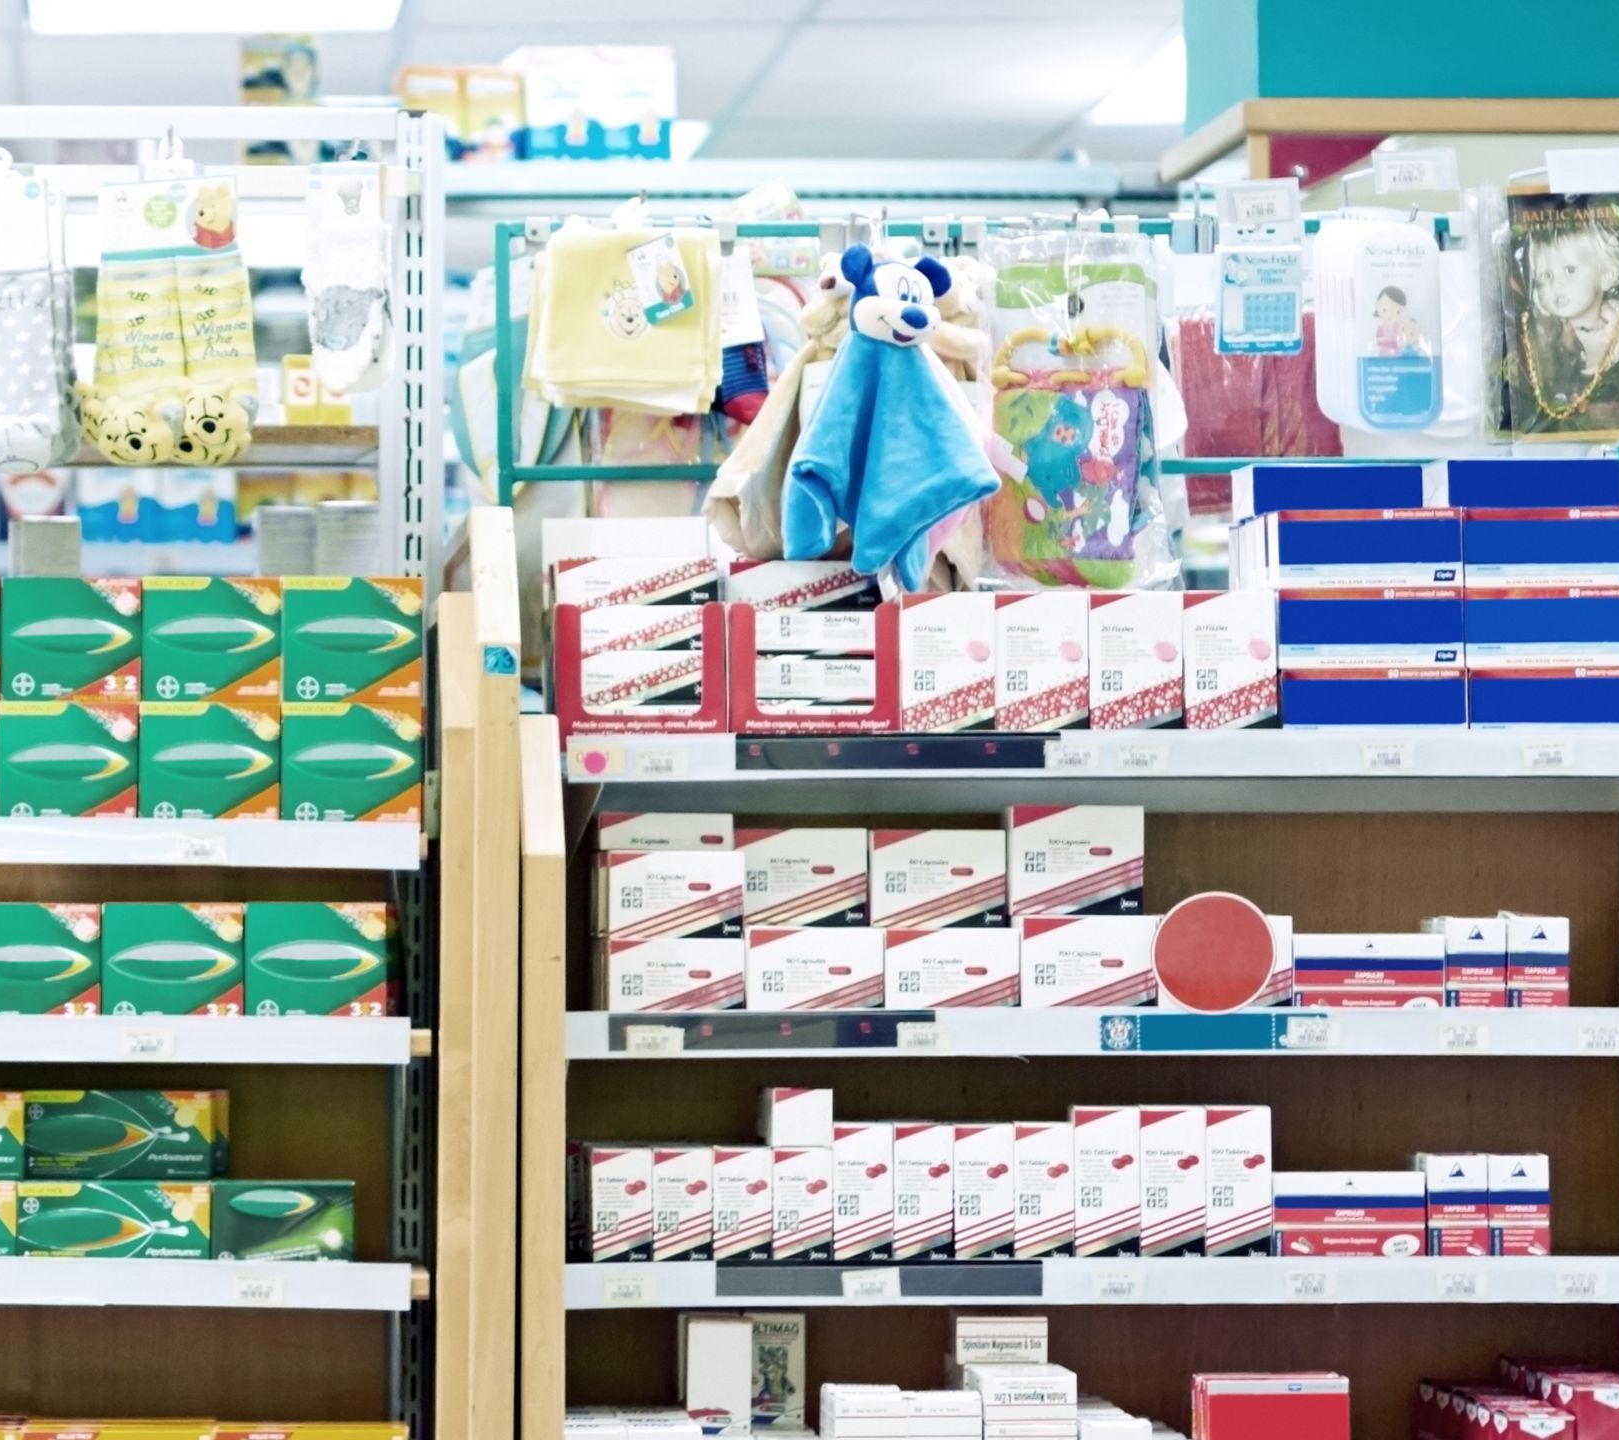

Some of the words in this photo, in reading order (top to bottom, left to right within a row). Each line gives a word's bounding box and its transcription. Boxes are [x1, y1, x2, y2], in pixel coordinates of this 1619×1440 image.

[1522, 206, 1568, 223] BALTIC
[193, 320, 247, 336] Winnie
[125, 330, 175, 343] Winnie
[207, 335, 233, 345] the
[134, 344, 159, 354] the
[204, 347, 240, 359] Pooh
[132, 358, 165, 369] Pooh
[573, 719, 597, 730] Muscle
[746, 719, 769, 730] Muscle
[148, 1153, 203, 1162] Performance
[146, 1247, 201, 1256] Performance
